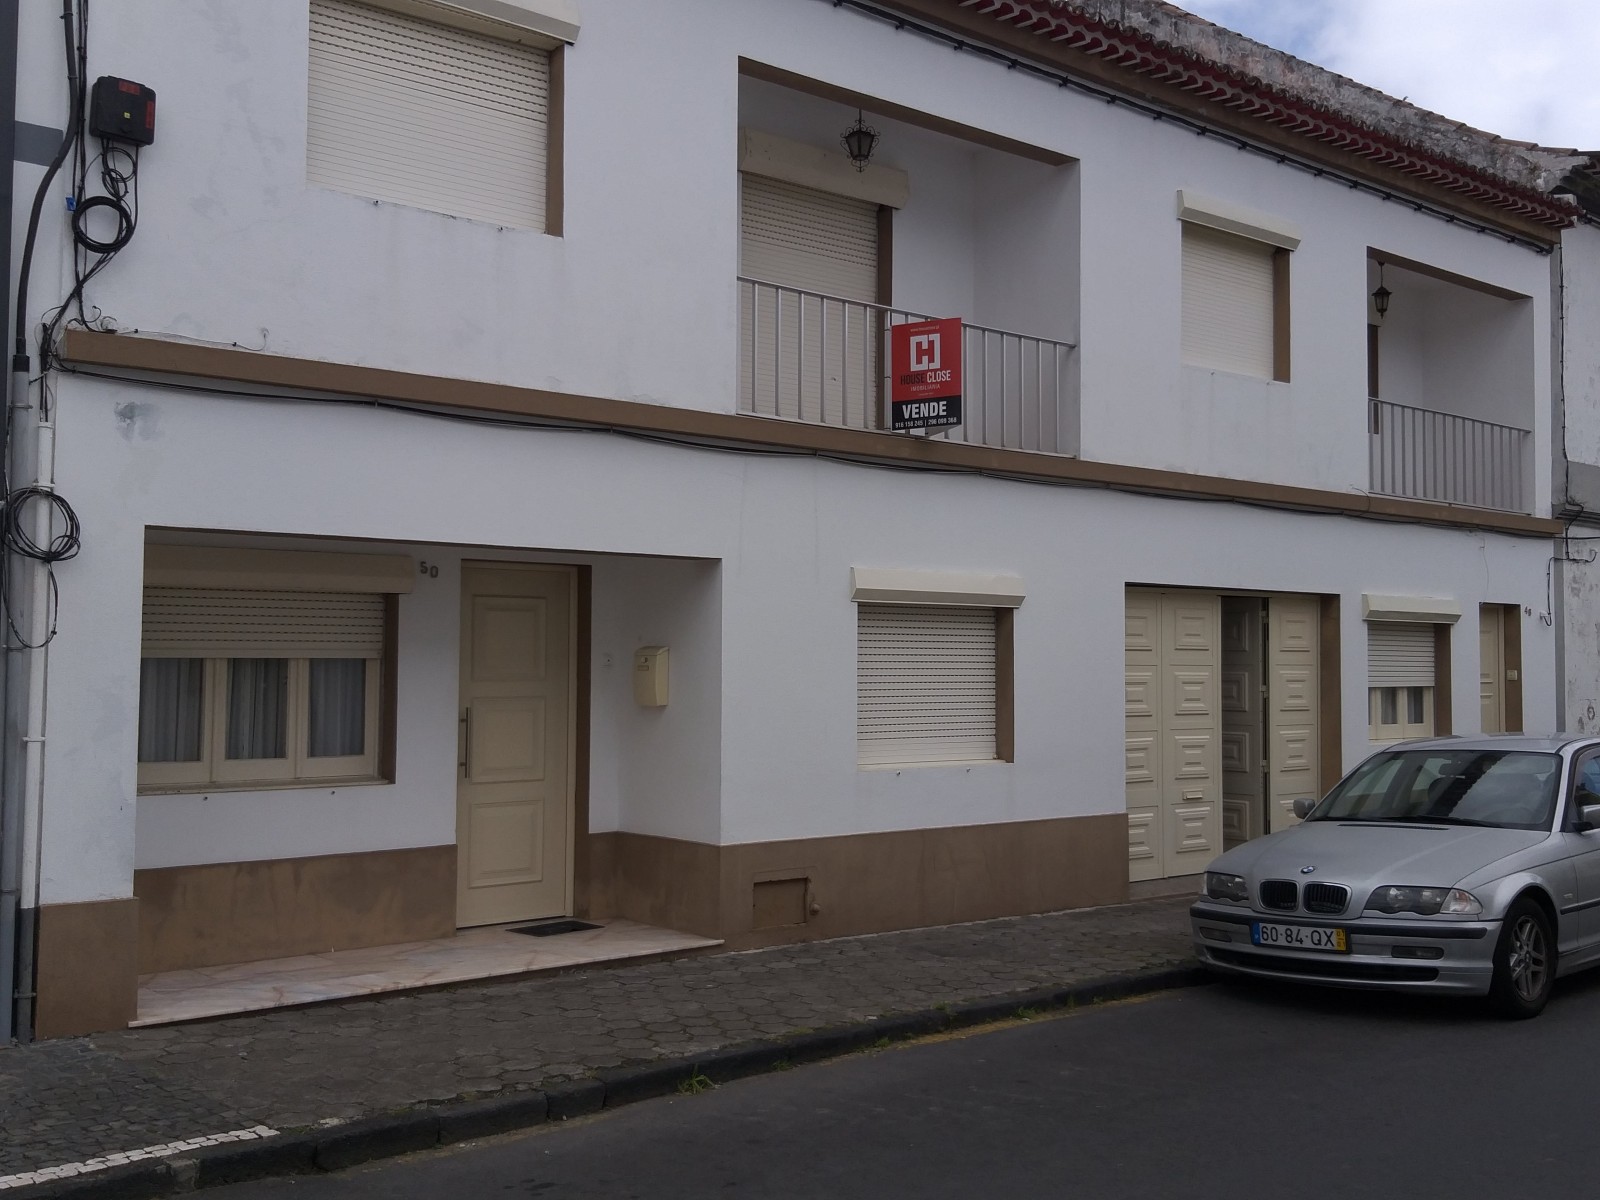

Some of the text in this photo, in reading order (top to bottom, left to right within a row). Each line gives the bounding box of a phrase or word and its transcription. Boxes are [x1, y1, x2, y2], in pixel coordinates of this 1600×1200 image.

[900, 370, 951, 385] HOUSE CLOSE
[902, 401, 947, 419] VENDE
[420, 561, 439, 578] 50
